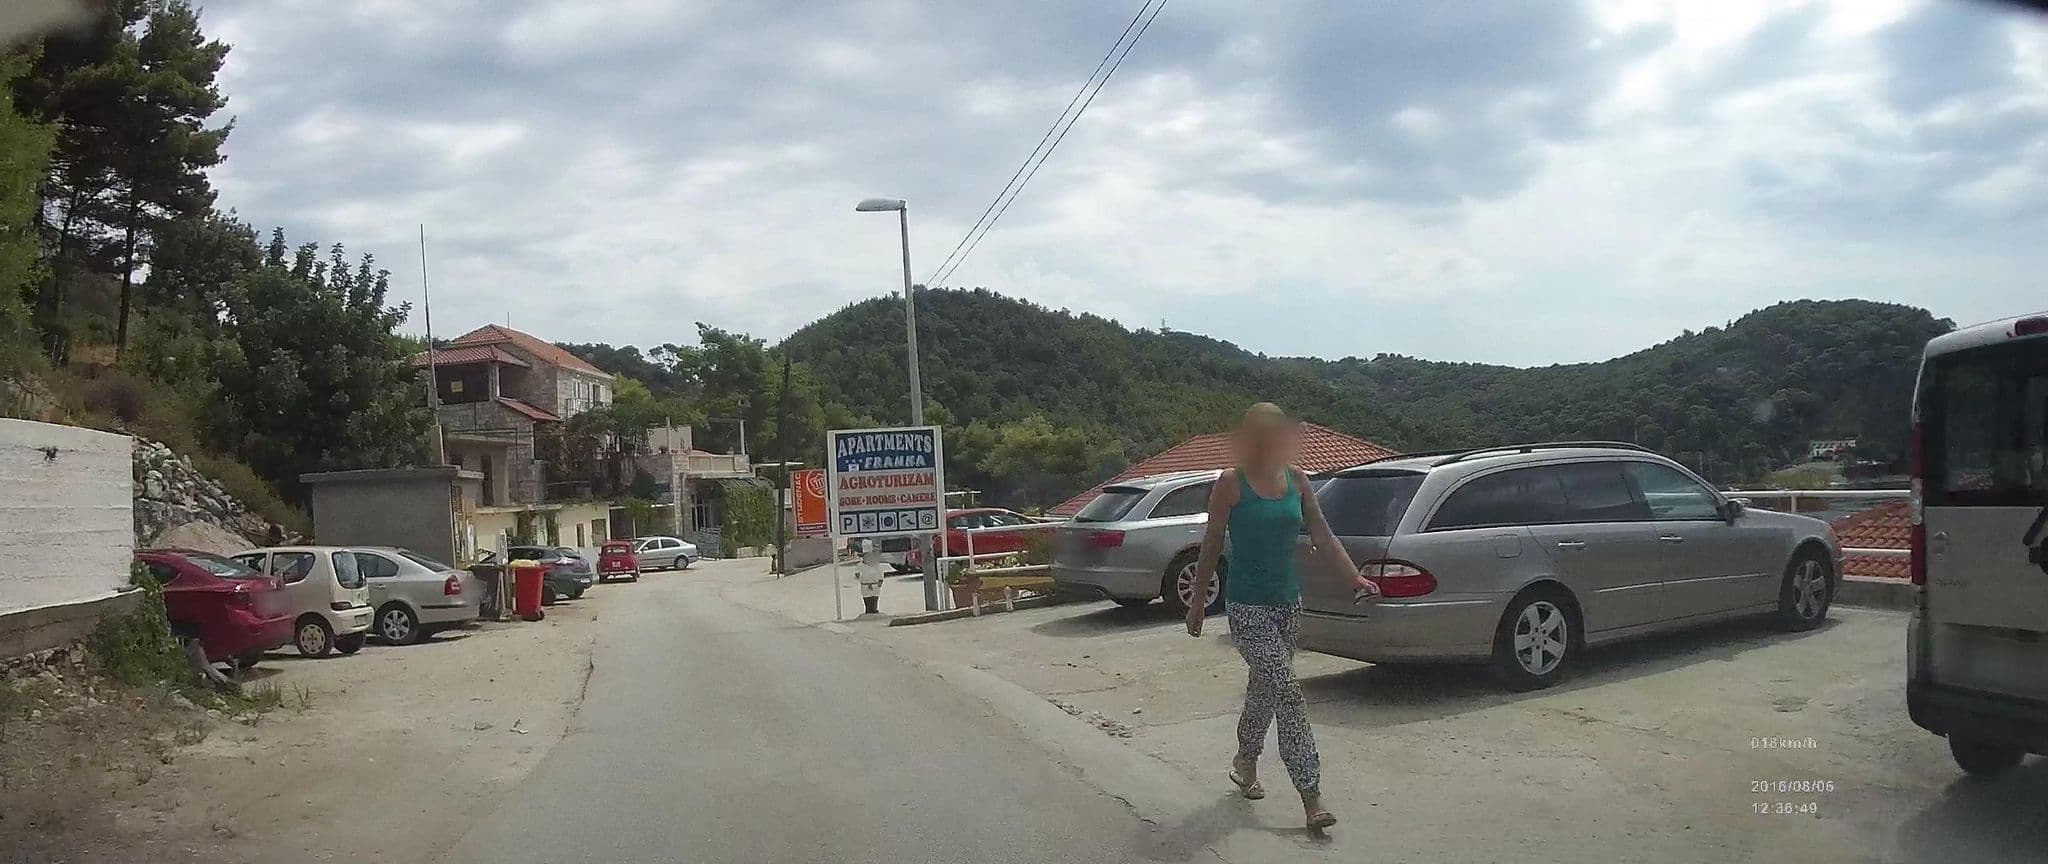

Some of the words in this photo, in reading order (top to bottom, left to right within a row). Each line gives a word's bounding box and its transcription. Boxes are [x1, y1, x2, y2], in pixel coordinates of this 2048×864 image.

[837, 433, 932, 458] APARTMENTS
[864, 455, 927, 469] FRANKA
[839, 472, 935, 490] AGROTURIZAM
